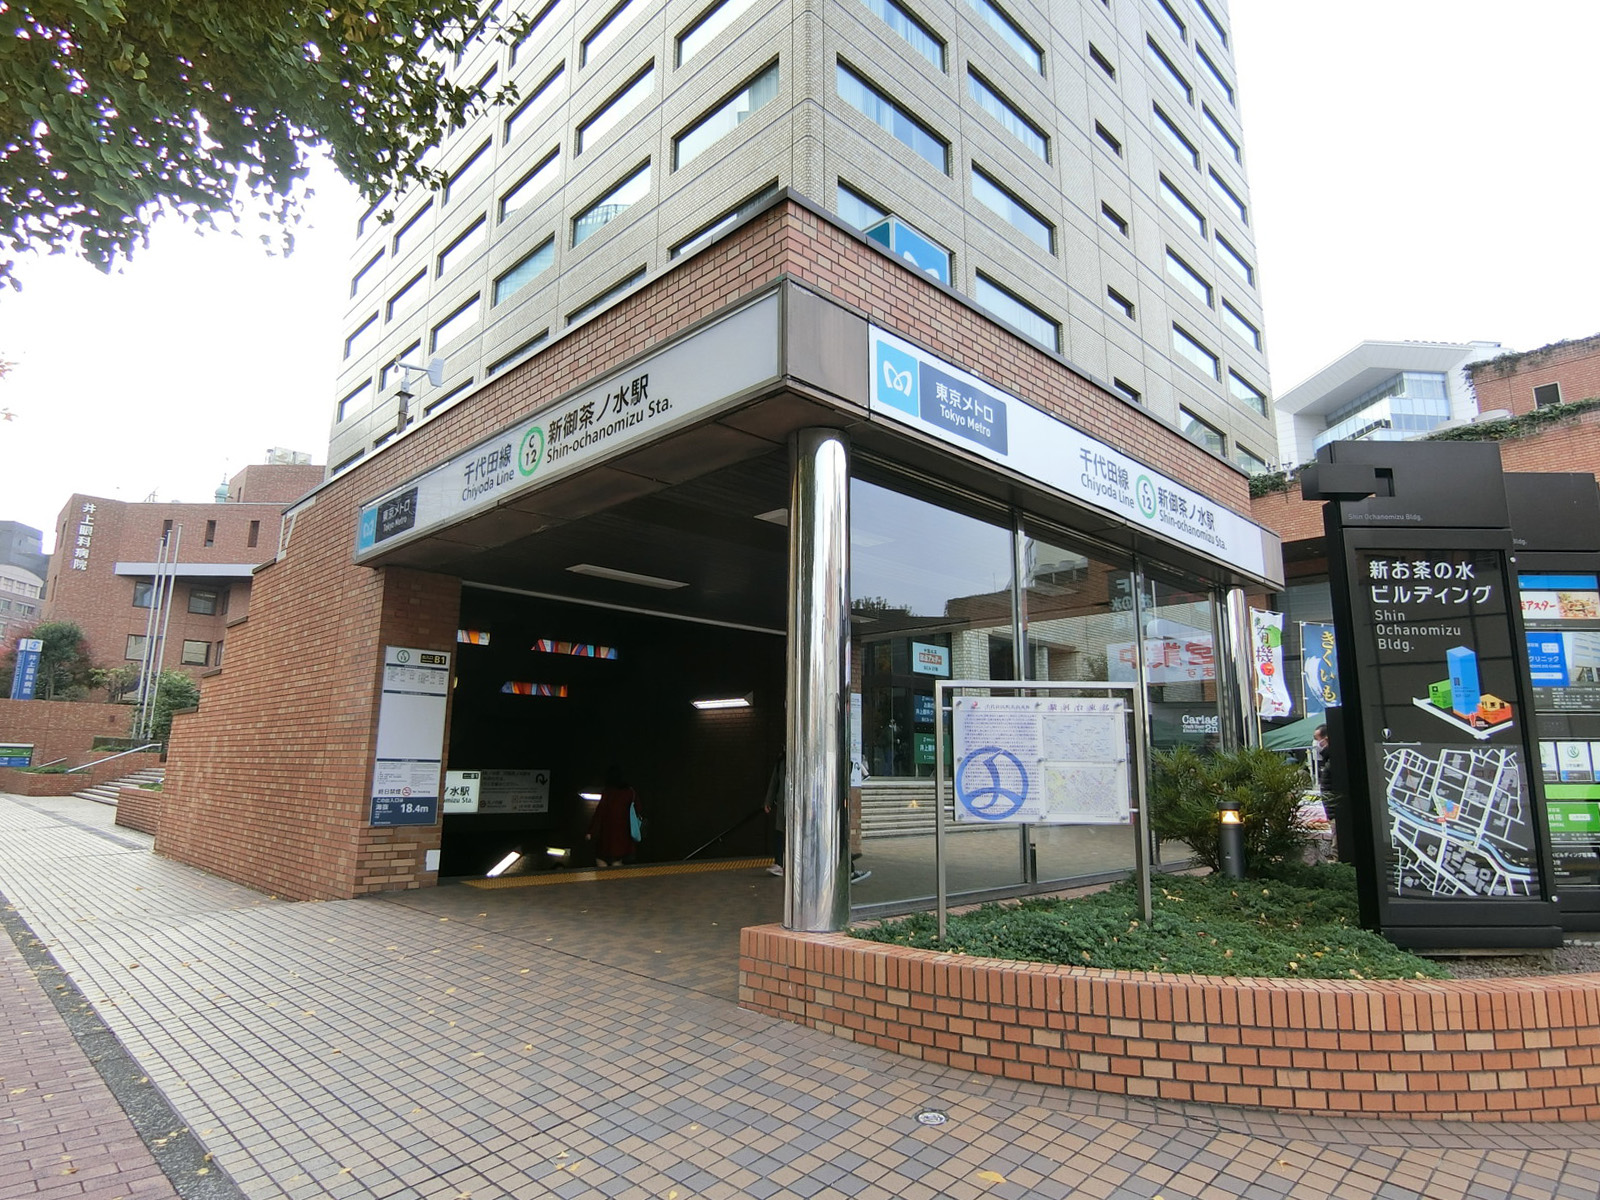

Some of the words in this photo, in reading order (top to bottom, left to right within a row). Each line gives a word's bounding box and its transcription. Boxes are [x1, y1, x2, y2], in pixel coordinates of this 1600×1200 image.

[547, 373, 649, 446] 新御茶ノ水駅
[935, 381, 994, 424] 東京メトロ
[546, 409, 644, 464] Shin-ochanomizu
[648, 397, 673, 418] Sta.
[939, 404, 965, 426] Tokyo
[967, 416, 991, 438] Metro
[464, 443, 512, 485] 千代田線
[525, 449, 537, 466] 12
[1080, 448, 1129, 490] 千代田線
[462, 477, 494, 501] Chiyoda
[496, 469, 514, 486] Line
[1080, 473, 1118, 500] Chiyoda
[1118, 489, 1135, 509] Line
[1143, 483, 1149, 495] C
[1141, 495, 1152, 510] 12
[1158, 486, 1215, 532] 新御茶ノ水駅
[1364, 513, 1404, 521] Ochanomizu
[1405, 513, 1423, 521] Bldg.
[73, 502, 97, 571] 井上眼科病院
[1158, 509, 1215, 545] Shin-ochanomizu
[1215, 535, 1228, 551] Sta.
[1369, 560, 1475, 580] 新お茶の水
[1371, 585, 1492, 605] ビルディング
[1374, 610, 1406, 621] Shin
[1376, 623, 1461, 636] Ochanomizu
[1378, 639, 1415, 653] Bldg.
[22, 654, 37, 695] 井上眼科病院
[1321, 631, 1337, 702] きくいも
[400, 803, 429, 813] 18.4m
